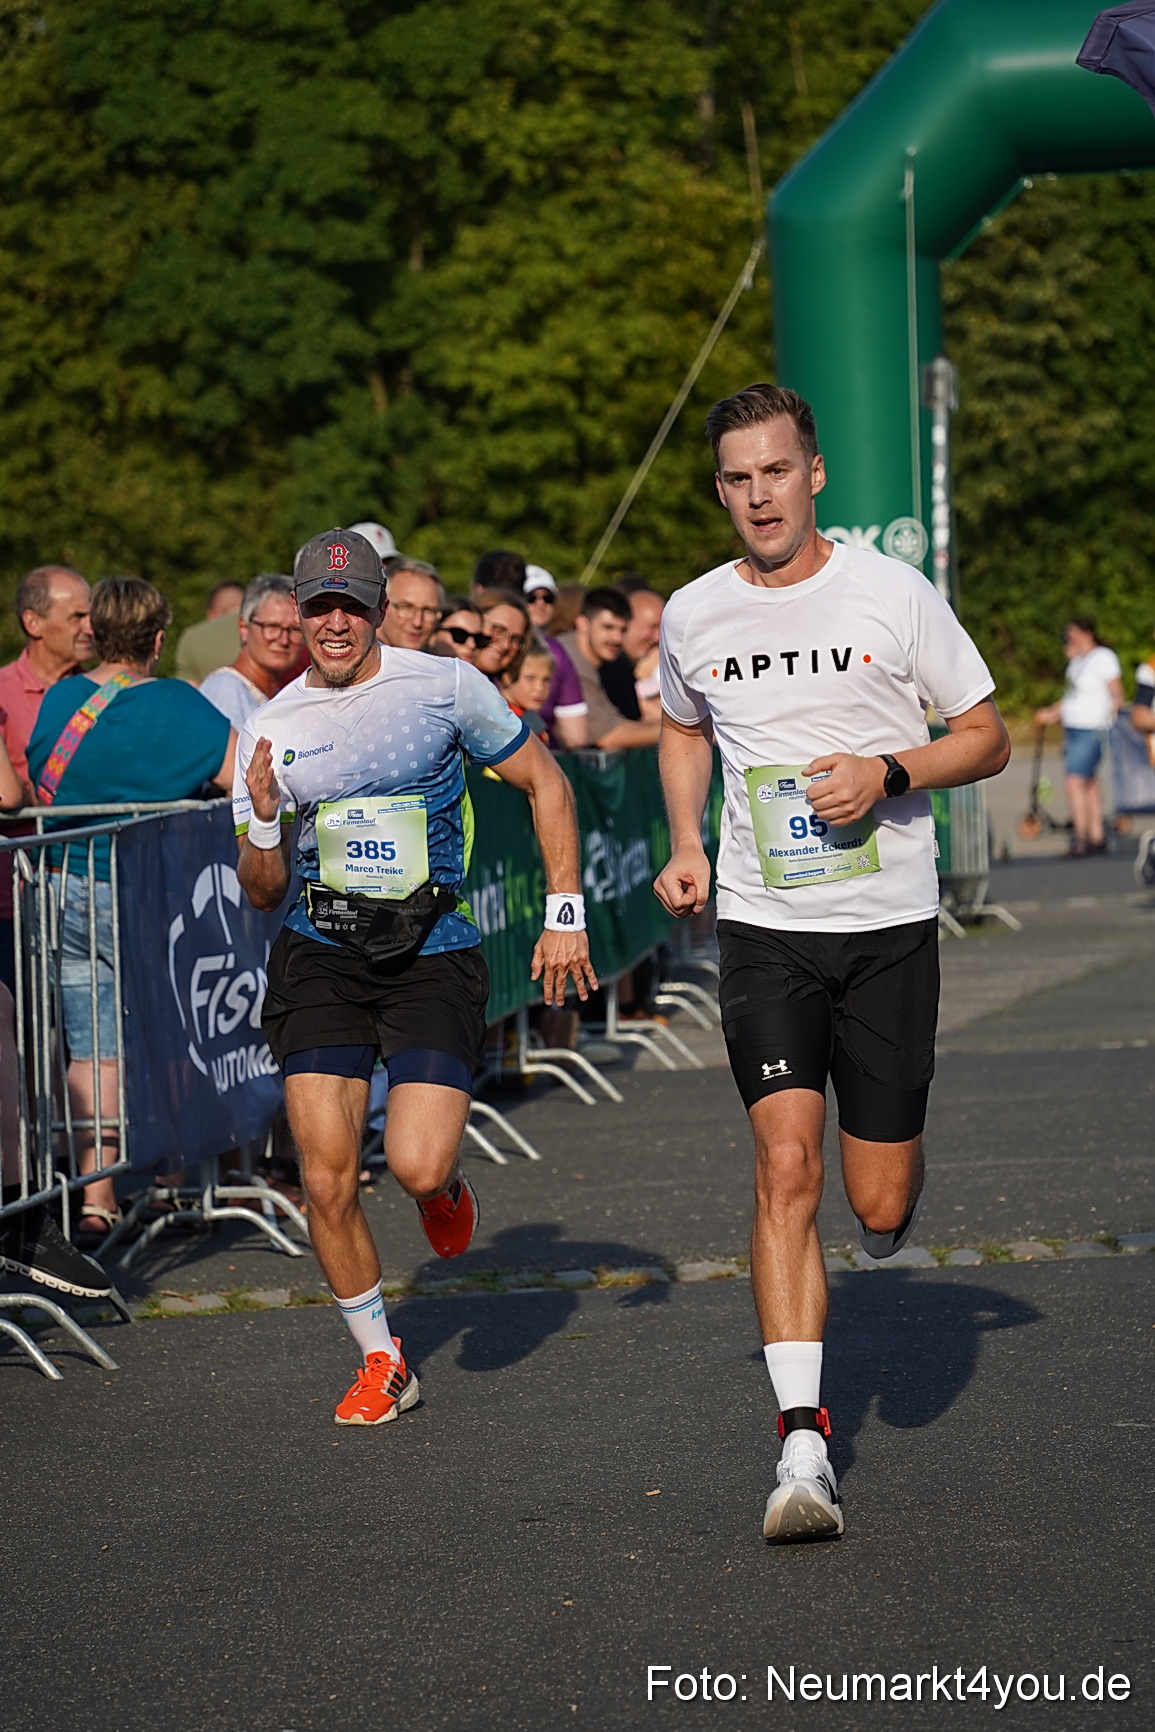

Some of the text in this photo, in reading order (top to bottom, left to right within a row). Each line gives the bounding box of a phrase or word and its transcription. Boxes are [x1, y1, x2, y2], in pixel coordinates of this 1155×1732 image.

[815, 523, 882, 553] OK
[326, 543, 350, 571] B
[724, 647, 853, 682] APTIV
[297, 743, 334, 760] Bionorica
[774, 789, 806, 798] Firmenlau
[342, 818, 376, 826] Firmenlauf
[789, 815, 828, 839] 95
[346, 840, 396, 861] 385
[768, 838, 862, 858] Alexander Eckerdt
[345, 863, 404, 875] Marco Treike
